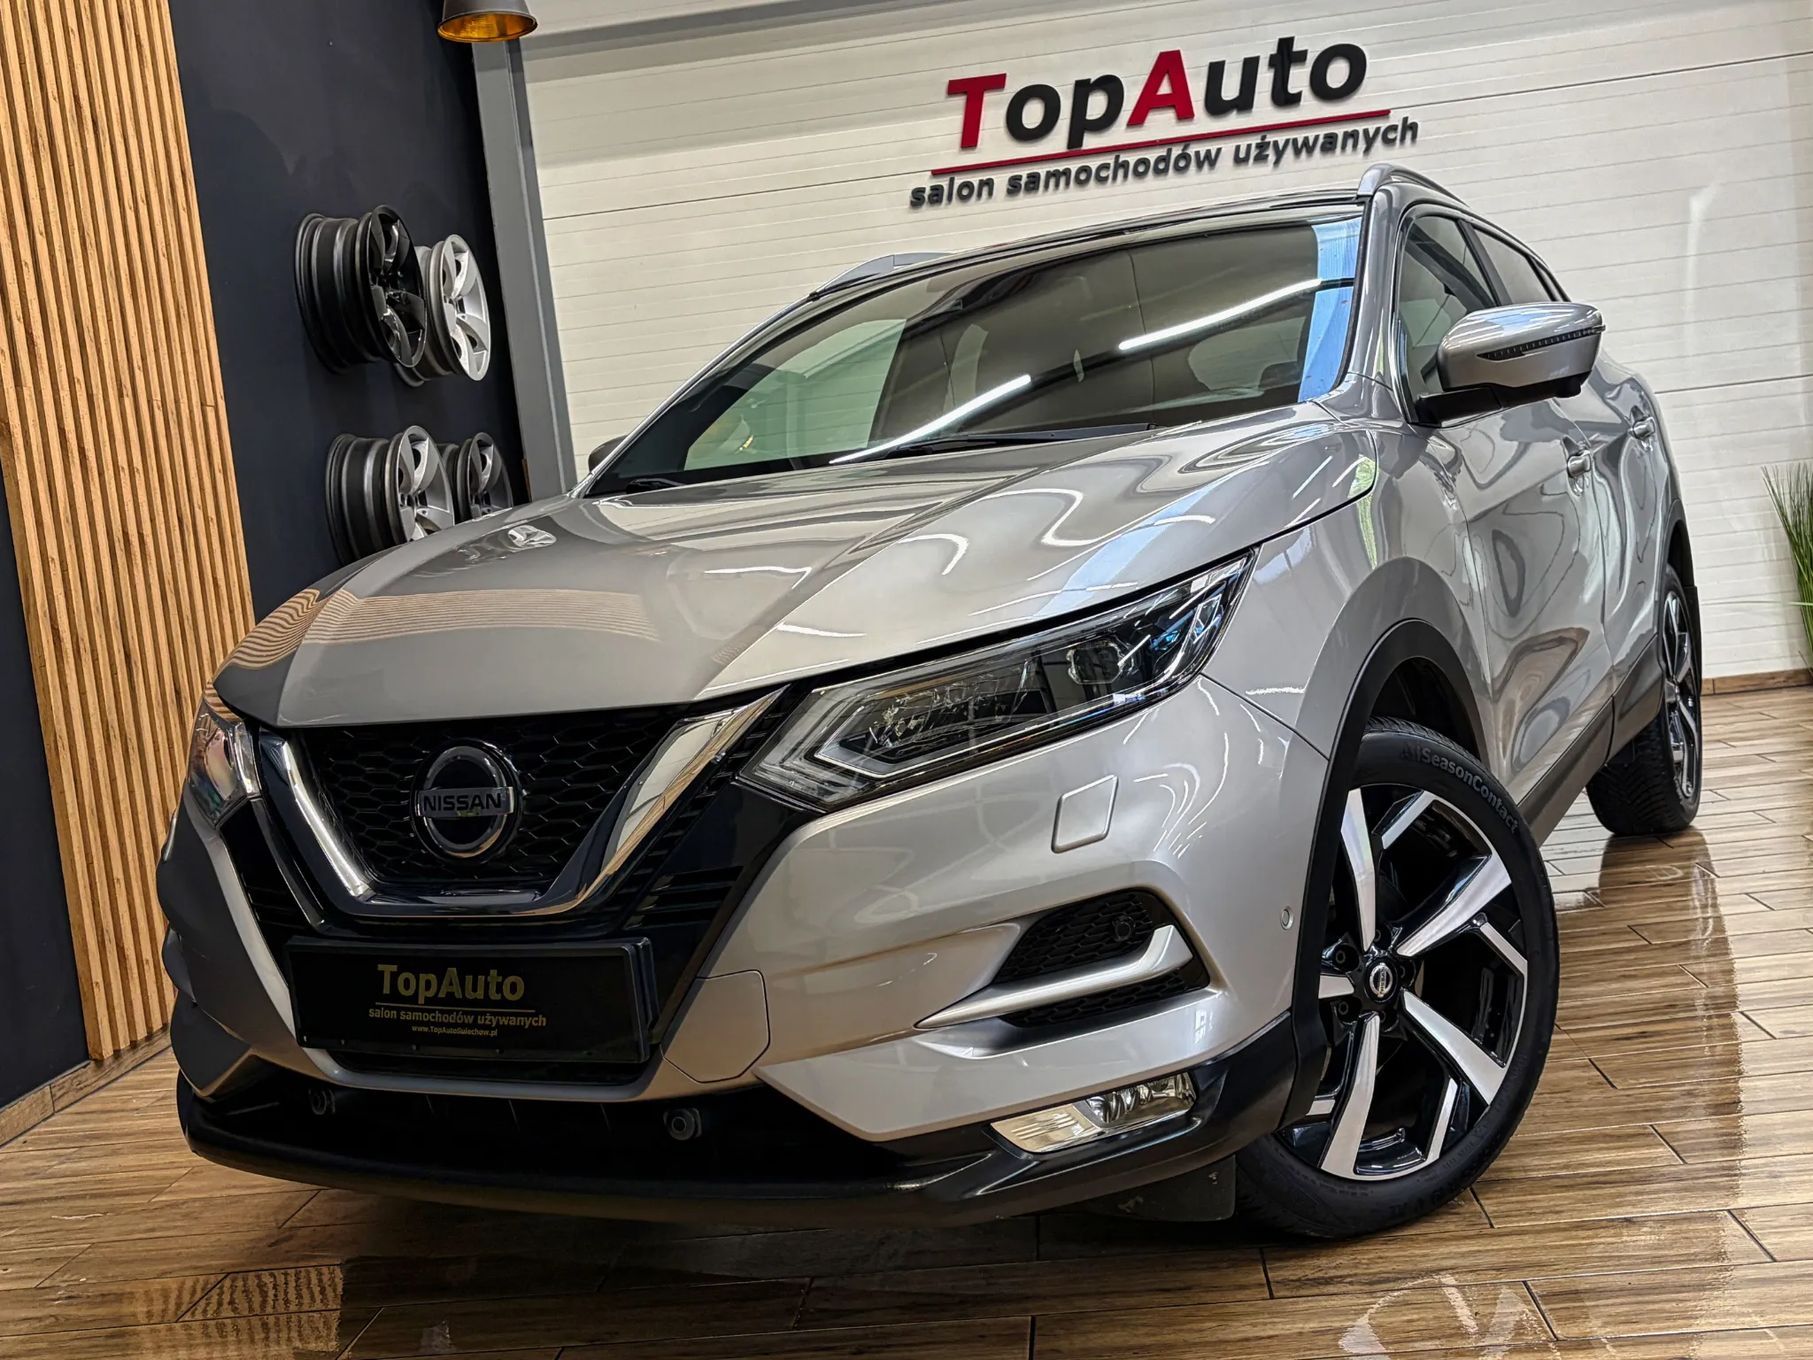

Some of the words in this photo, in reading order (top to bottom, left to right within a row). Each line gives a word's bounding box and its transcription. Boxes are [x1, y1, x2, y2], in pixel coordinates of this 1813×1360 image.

[946, 36, 1367, 150] TopAuto
[909, 175, 995, 208] salon
[1006, 143, 1223, 196] samochodów
[1233, 116, 1419, 167] używanych
[422, 792, 501, 812] NISSAN
[377, 964, 525, 1004] TopAuto
[368, 1007, 397, 1019] salon
[400, 1011, 474, 1025] samochodów
[477, 1014, 547, 1029] używanych
